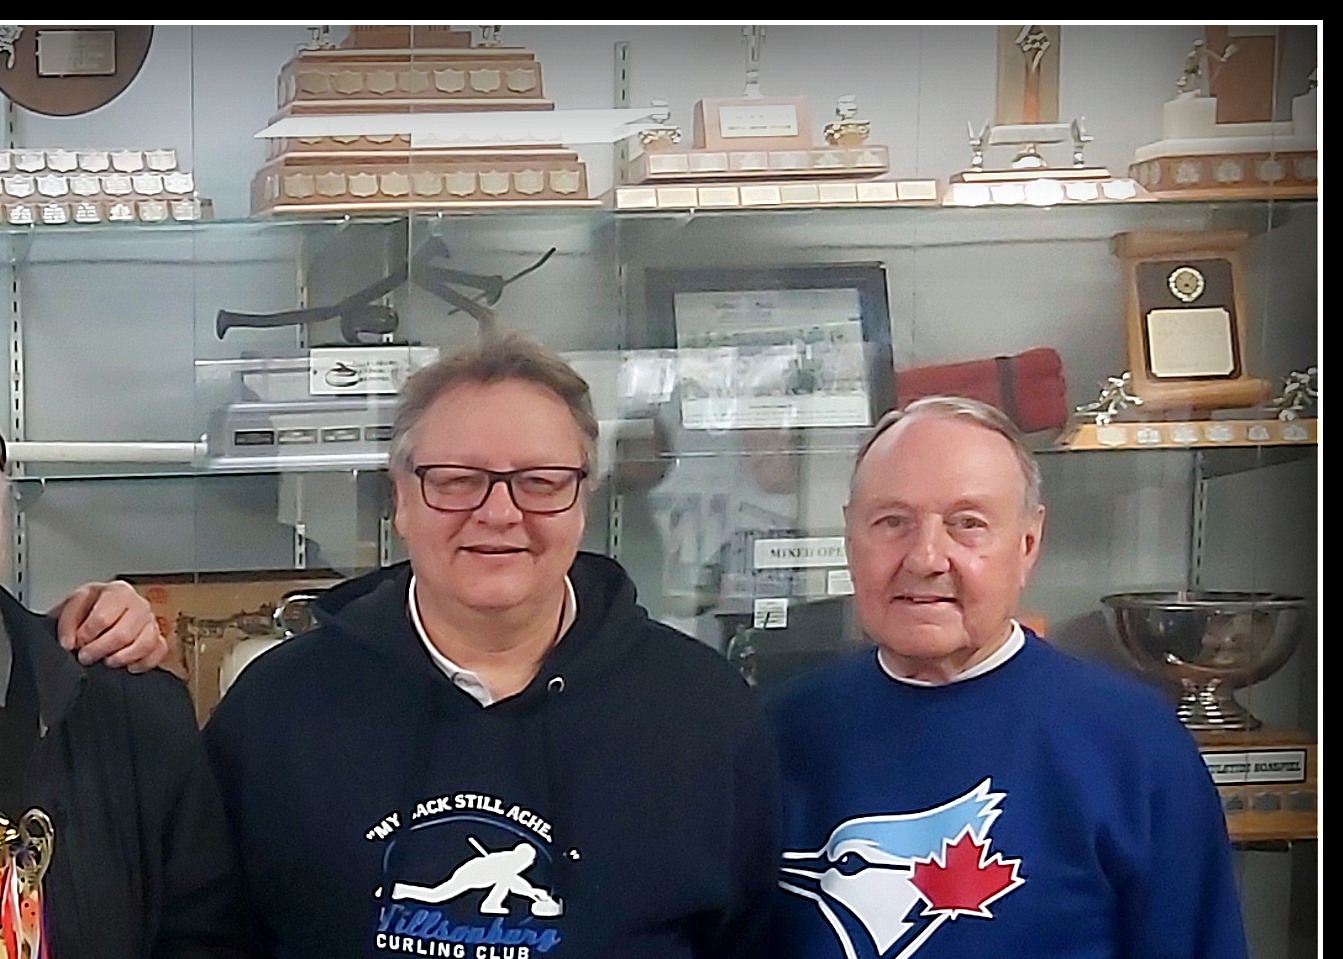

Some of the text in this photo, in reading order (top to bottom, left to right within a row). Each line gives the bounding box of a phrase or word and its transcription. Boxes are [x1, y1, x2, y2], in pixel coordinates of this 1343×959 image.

[412, 796, 452, 820] ACK
[454, 794, 505, 815] STILL
[376, 933, 465, 959] CURLING
